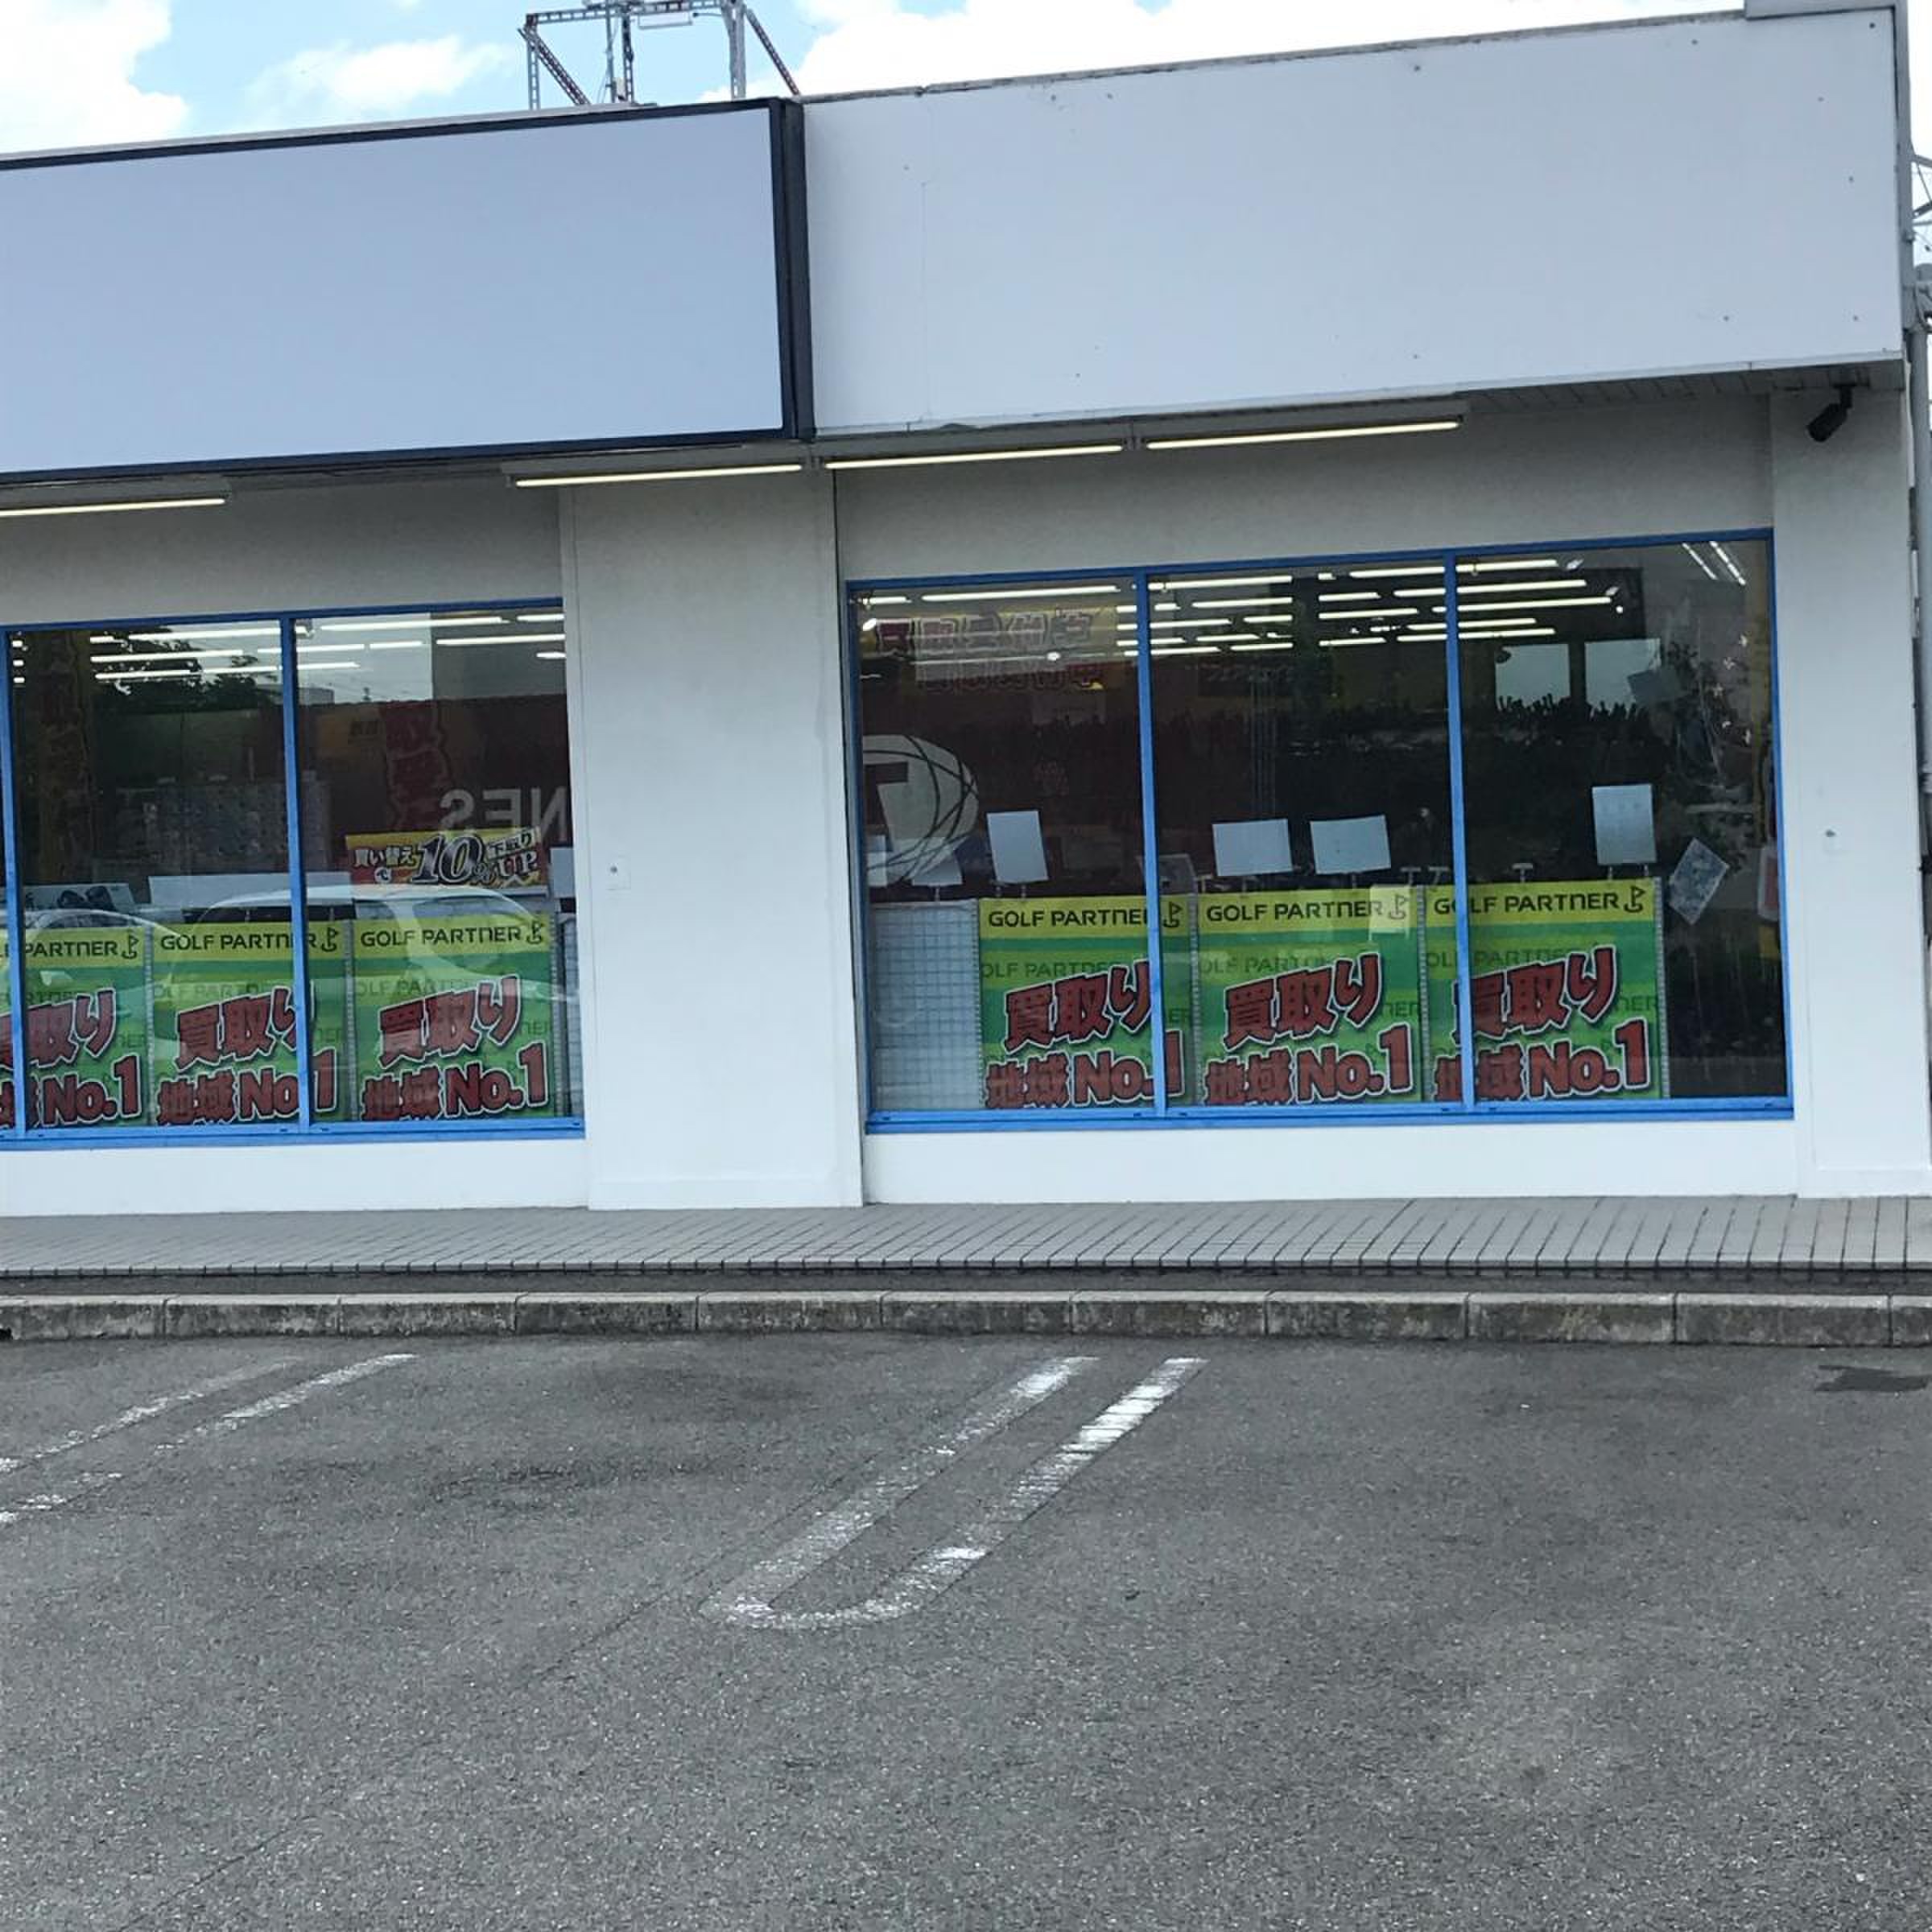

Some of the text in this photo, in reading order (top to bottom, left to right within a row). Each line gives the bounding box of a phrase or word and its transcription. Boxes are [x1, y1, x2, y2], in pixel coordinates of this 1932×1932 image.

[1207, 901, 1382, 922] GOLF PARTNER
[1434, 893, 1619, 914] GLF PARTNER
[989, 909, 1147, 927] GOLF PARTNE
[161, 932, 316, 951] GOLF PARTNR
[361, 927, 522, 947] GOLF PARTNER
[1005, 958, 1152, 1055] 買取り
[1223, 952, 1381, 1052] 買取り
[0, 988, 116, 1070] 取り
[378, 974, 520, 1069] 買取り
